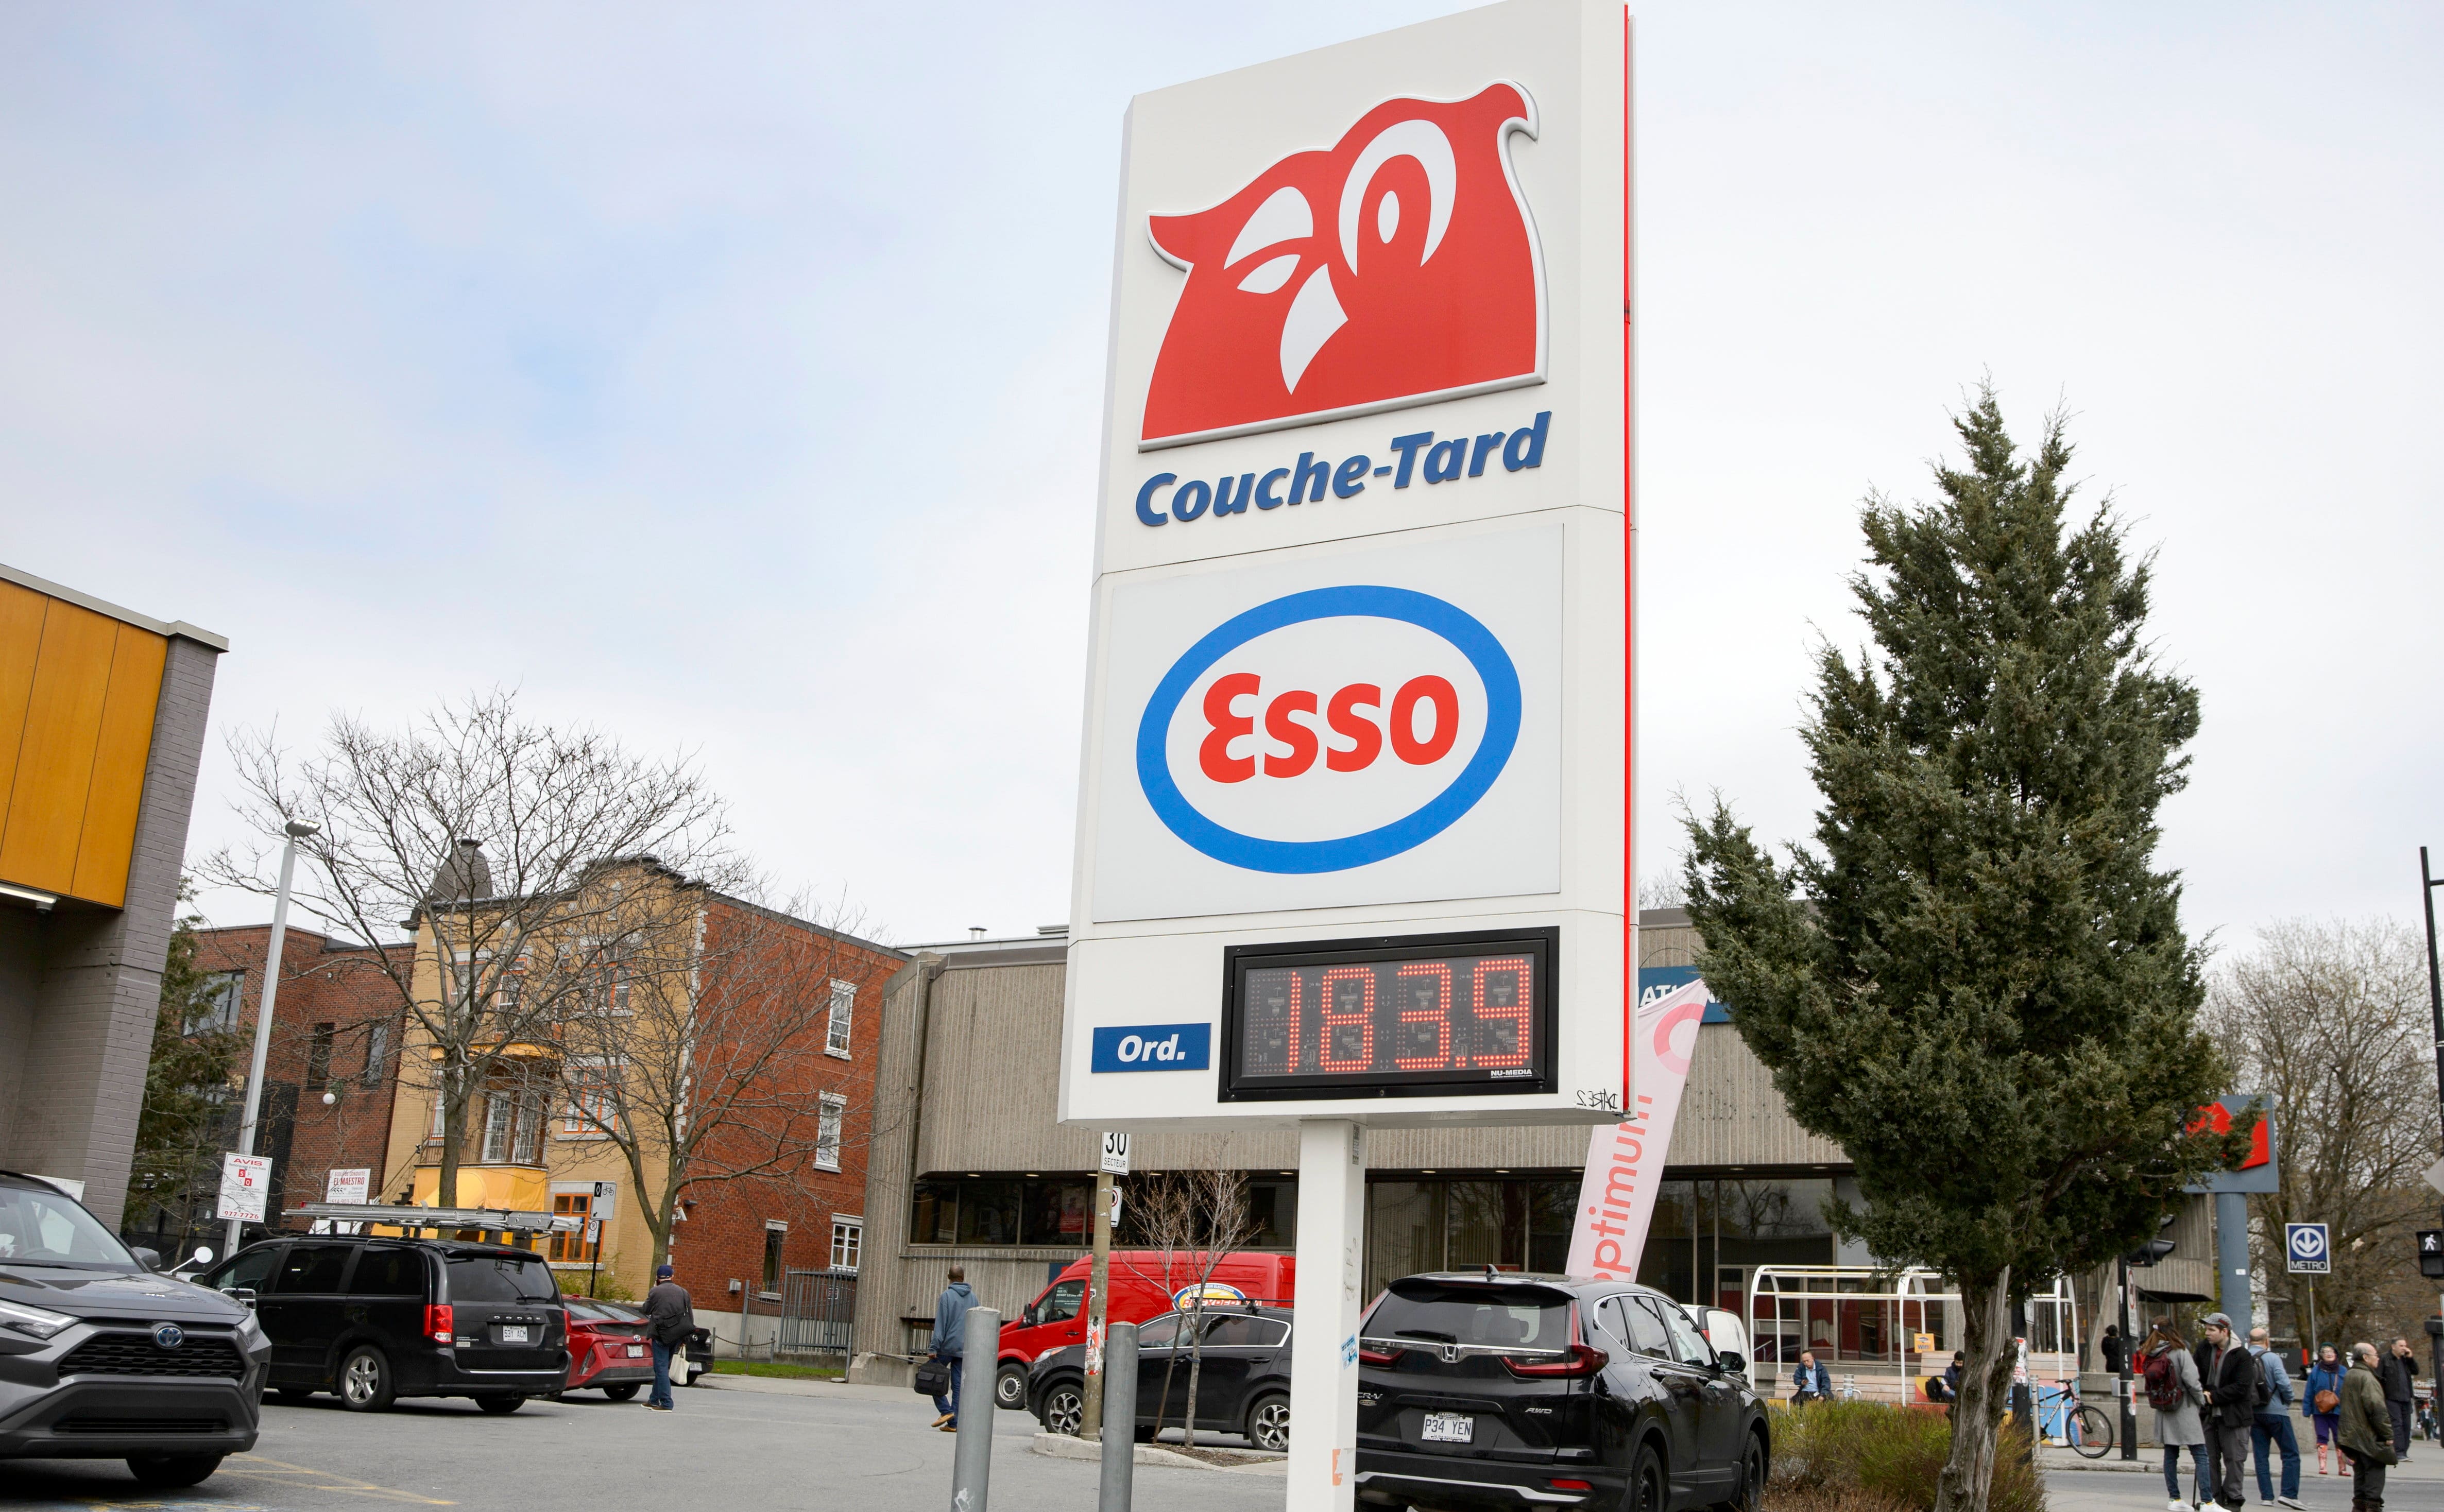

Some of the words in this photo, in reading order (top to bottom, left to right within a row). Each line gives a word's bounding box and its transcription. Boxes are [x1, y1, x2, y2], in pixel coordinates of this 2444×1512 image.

[1136, 410, 1552, 527] Couche-Tard
[1288, 958, 1530, 1073] 183.9
[1118, 1034, 1186, 1062] Ord.
[1106, 1133, 1127, 1156] 30
[1104, 1157, 1126, 1168] SECTEUR
[340, 1177, 365, 1185] MAESTRO
[225, 1211, 259, 1219] 977-7726
[1425, 1419, 1445, 1433] P34
[1452, 1421, 1472, 1436] YEN
